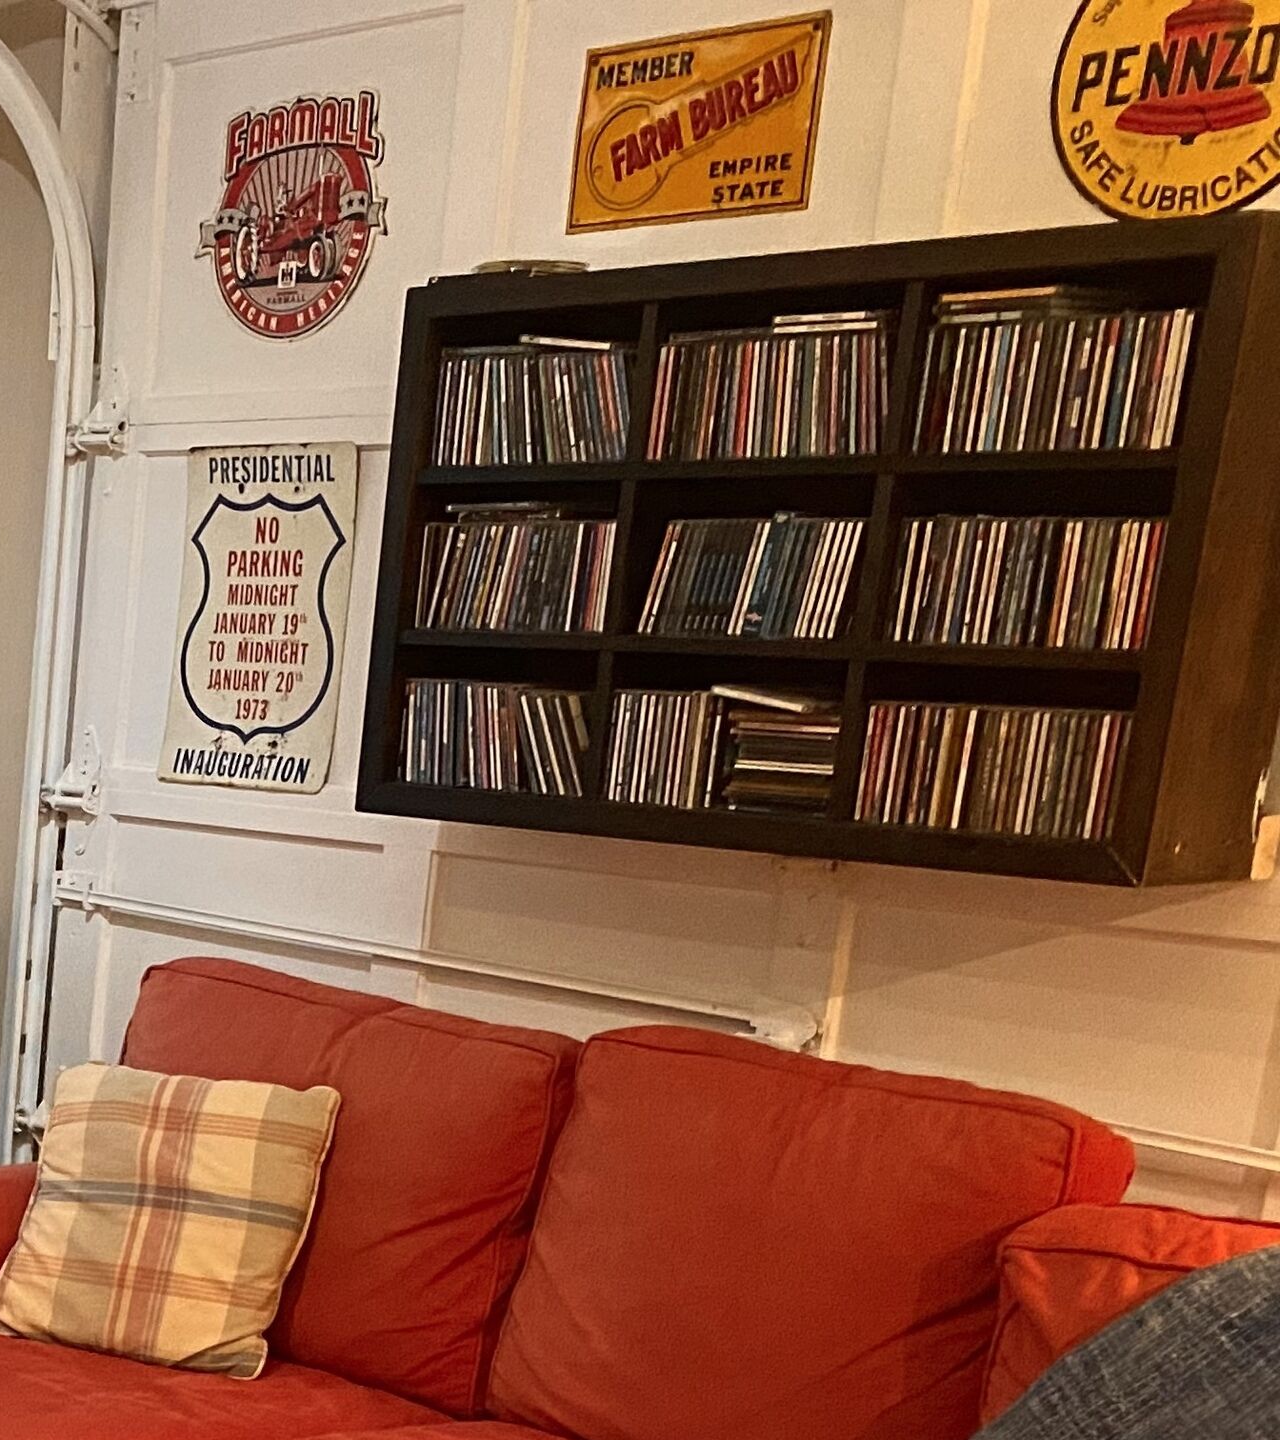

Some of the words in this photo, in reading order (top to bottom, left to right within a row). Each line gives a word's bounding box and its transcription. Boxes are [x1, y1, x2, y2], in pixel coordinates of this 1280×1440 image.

[596, 51, 694, 91] MEMBER
[1071, 24, 1280, 113] PENNZO
[610, 110, 683, 182] FARM
[689, 50, 798, 141] BUREAU
[224, 91, 378, 180] FARMALL
[709, 153, 792, 179] EMPIRE
[1070, 120, 1125, 192] SAFE
[1120, 127, 1280, 211] LUBRICATI
[711, 180, 784, 204] STATE
[218, 246, 279, 331] AMERICAN
[296, 231, 365, 328] HERITAGE
[209, 455, 335, 484] PRESIDENTIAL
[255, 517, 280, 545] NO
[227, 550, 303, 577] PARKING
[227, 584, 299, 606] MIDNIGHT
[213, 613, 277, 635] JANUARY
[208, 641, 226, 662] TO
[237, 641, 309, 666] MIDNIGHT
[207, 670, 269, 692] JANUARY
[235, 699, 269, 721] 1973
[173, 748, 311, 784] INAUGURATION
